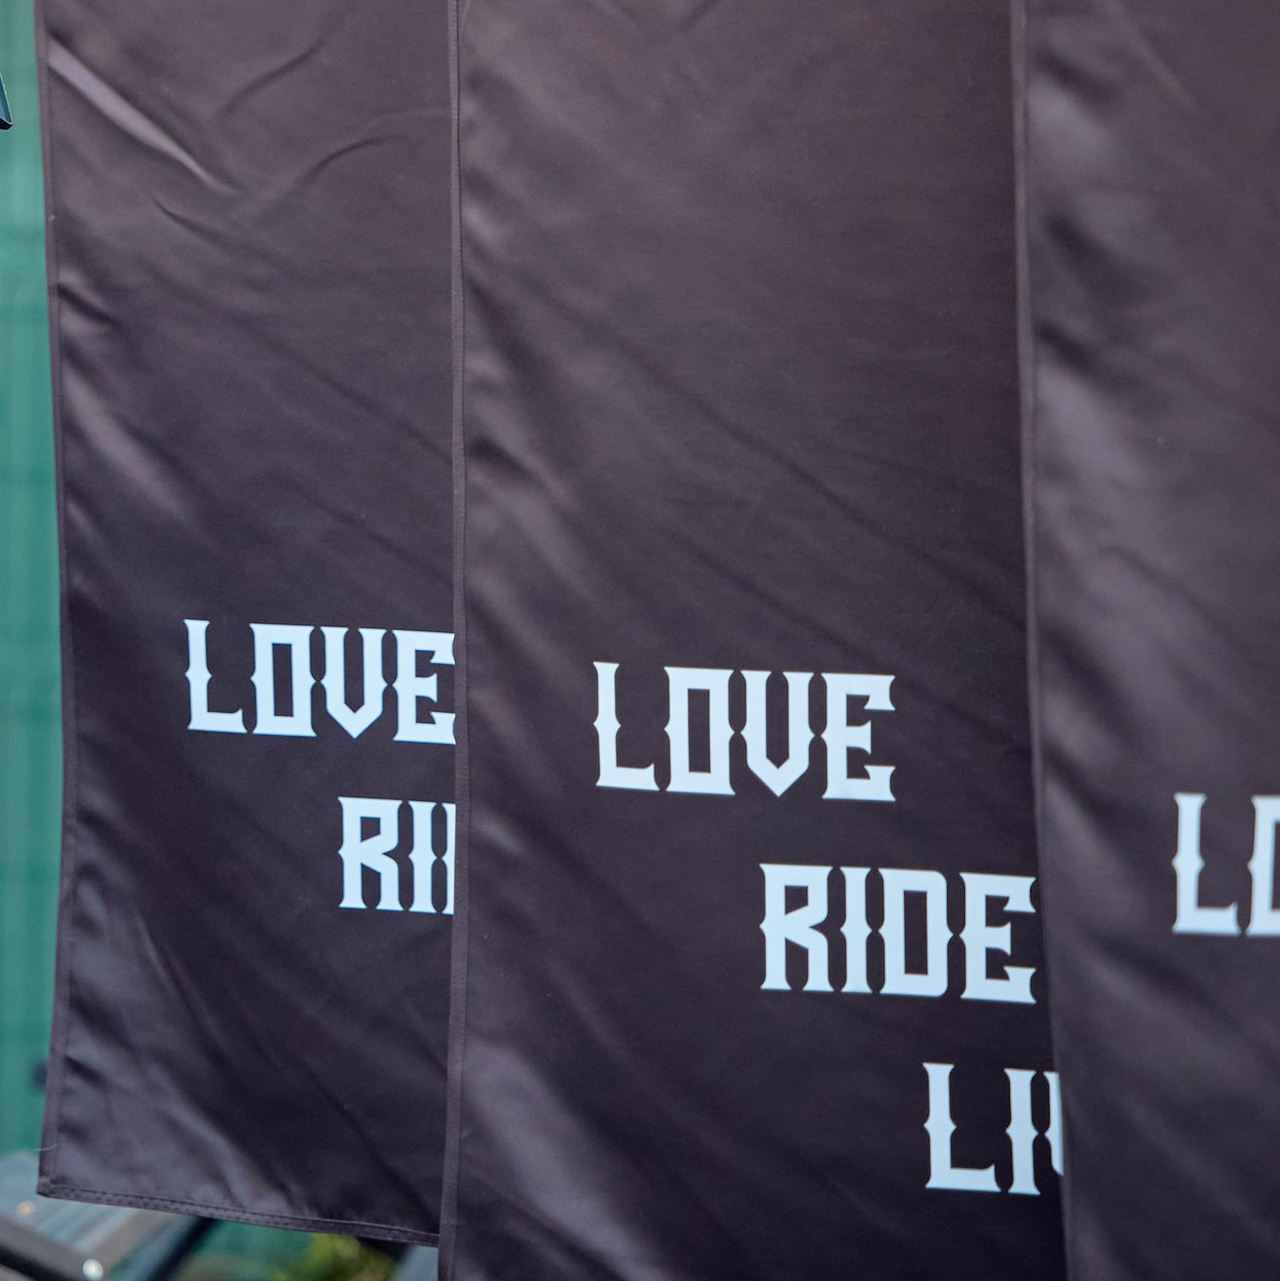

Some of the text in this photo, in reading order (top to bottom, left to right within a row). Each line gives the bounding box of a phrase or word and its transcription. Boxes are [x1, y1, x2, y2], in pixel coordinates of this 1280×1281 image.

[184, 619, 456, 745] LOVE
[593, 661, 896, 802] LOVE
[759, 863, 1037, 1004] RIDE
